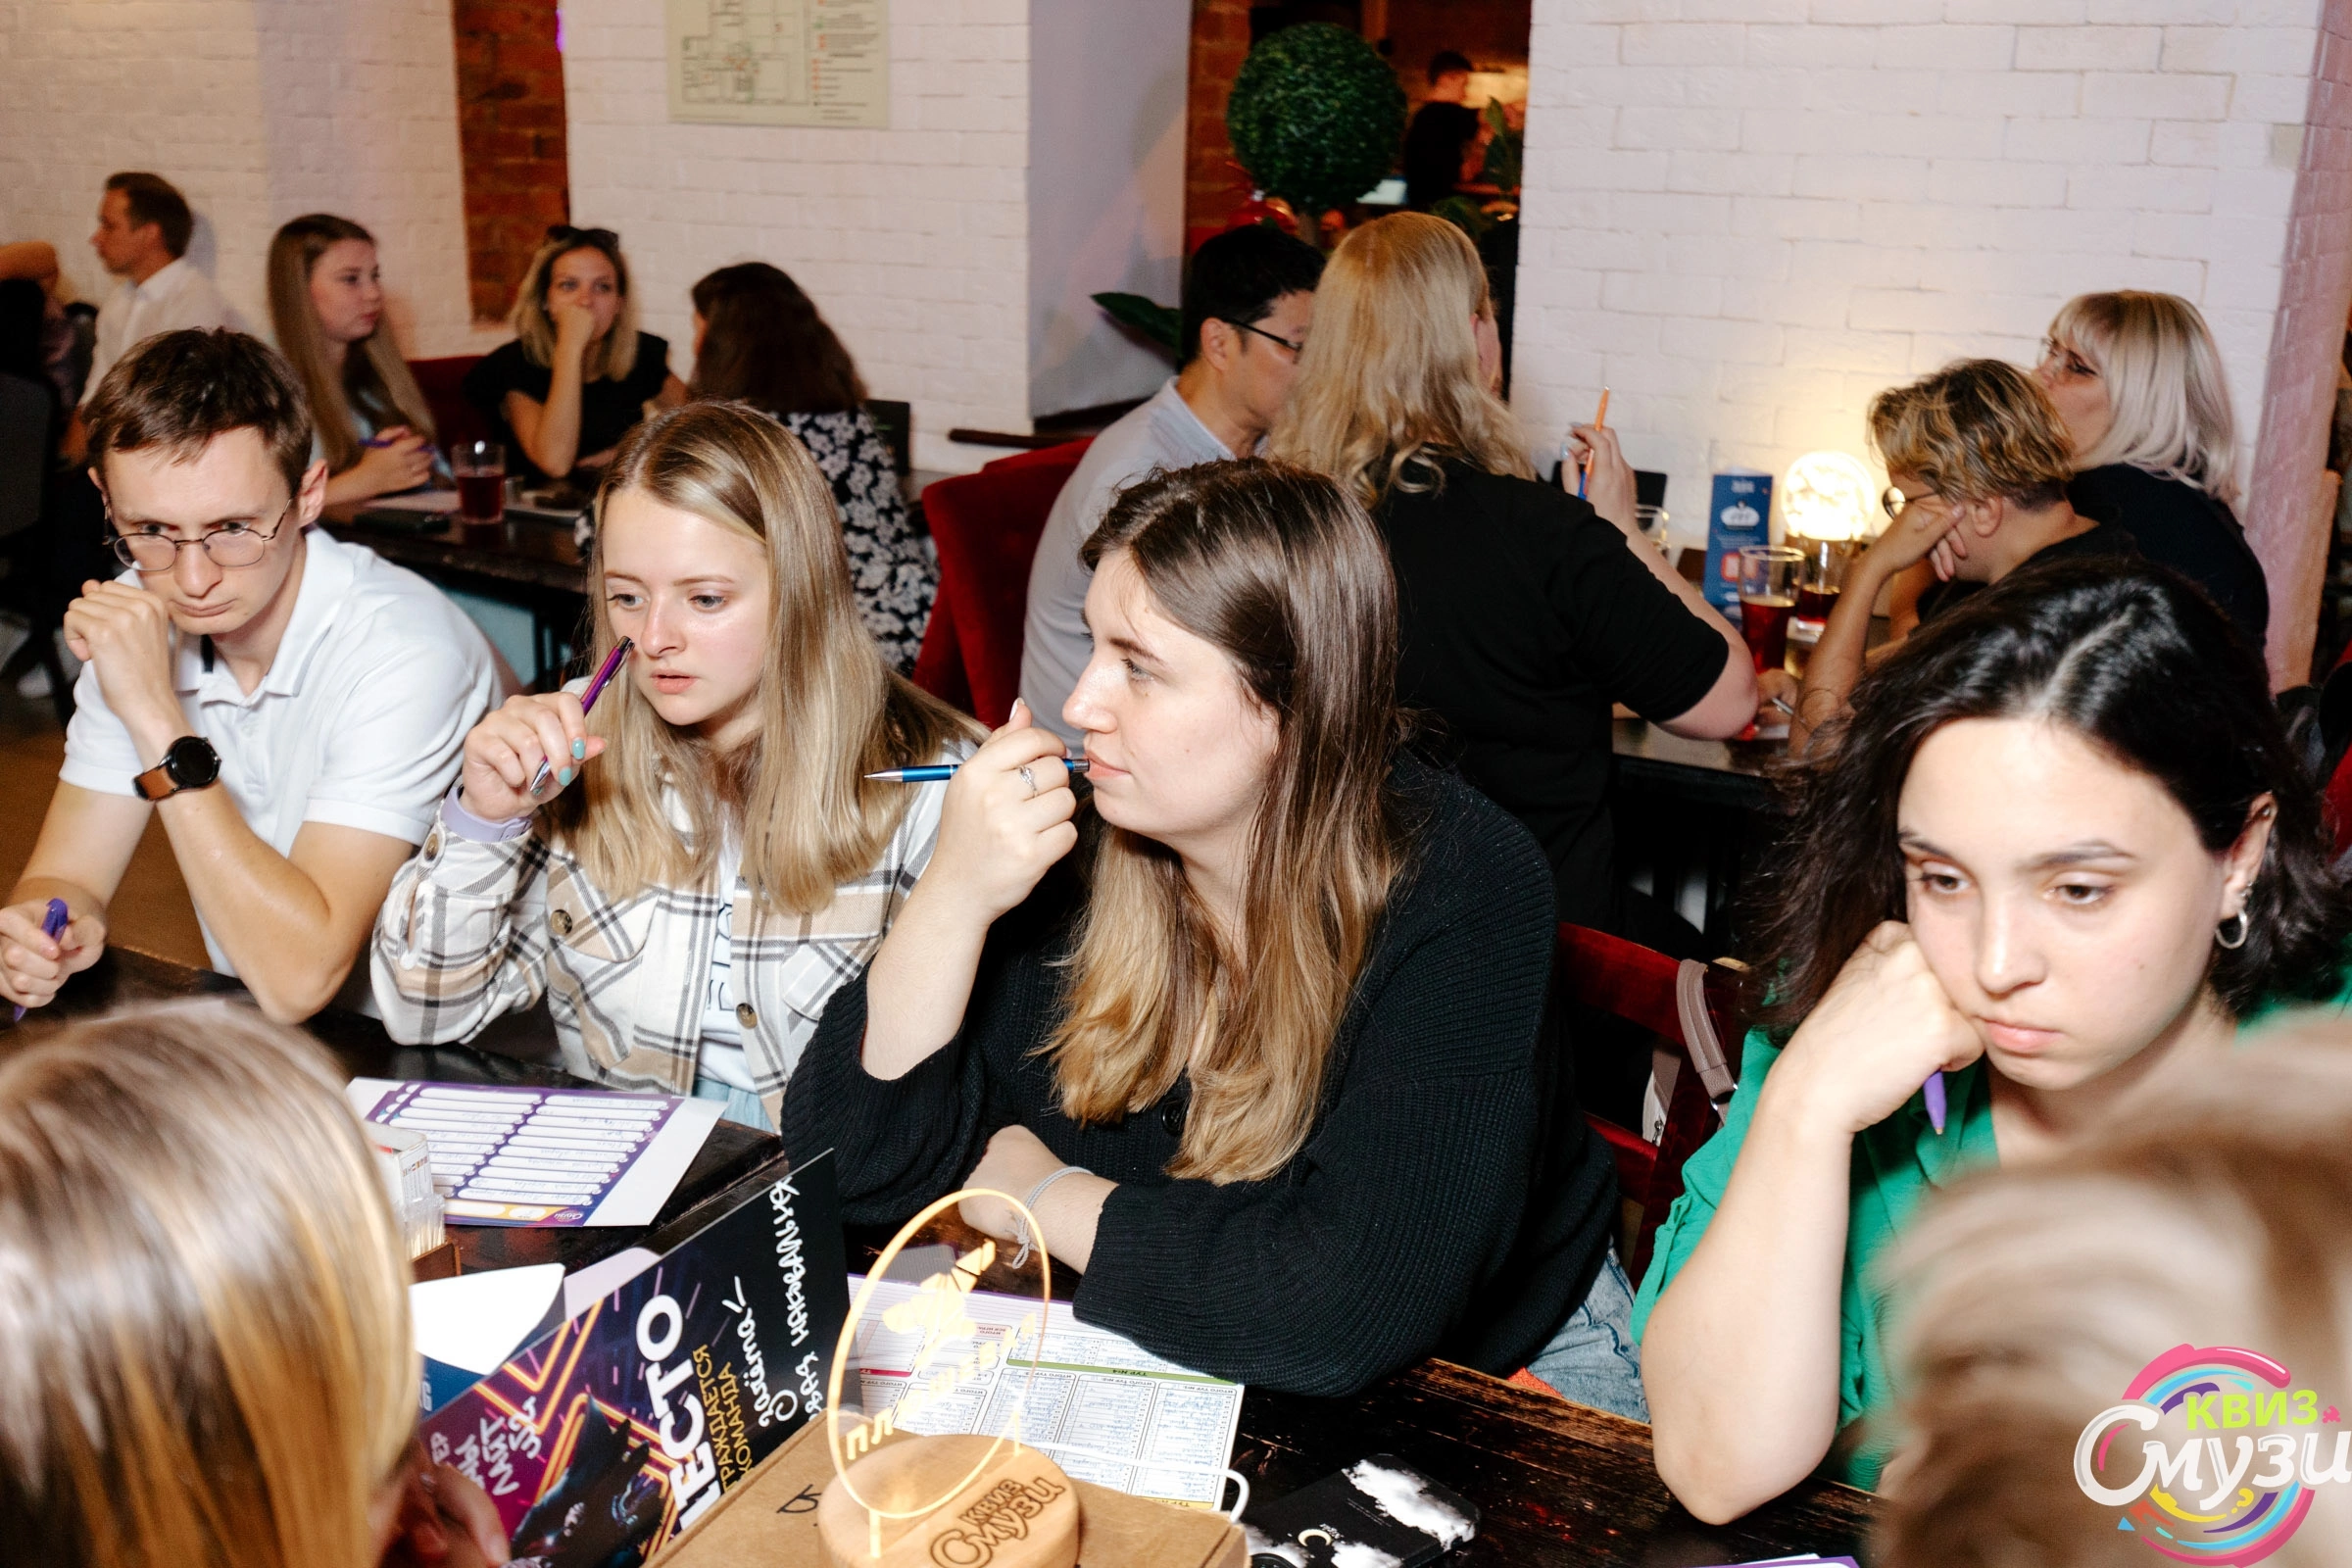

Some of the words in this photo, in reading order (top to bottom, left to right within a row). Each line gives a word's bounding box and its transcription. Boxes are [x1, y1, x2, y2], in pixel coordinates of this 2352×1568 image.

[692, 1345, 738, 1494] ГРАЖДАЕТСЯ
[930, 1475, 1067, 1568] Смузи
[957, 1478, 1025, 1530] КВИЗ
